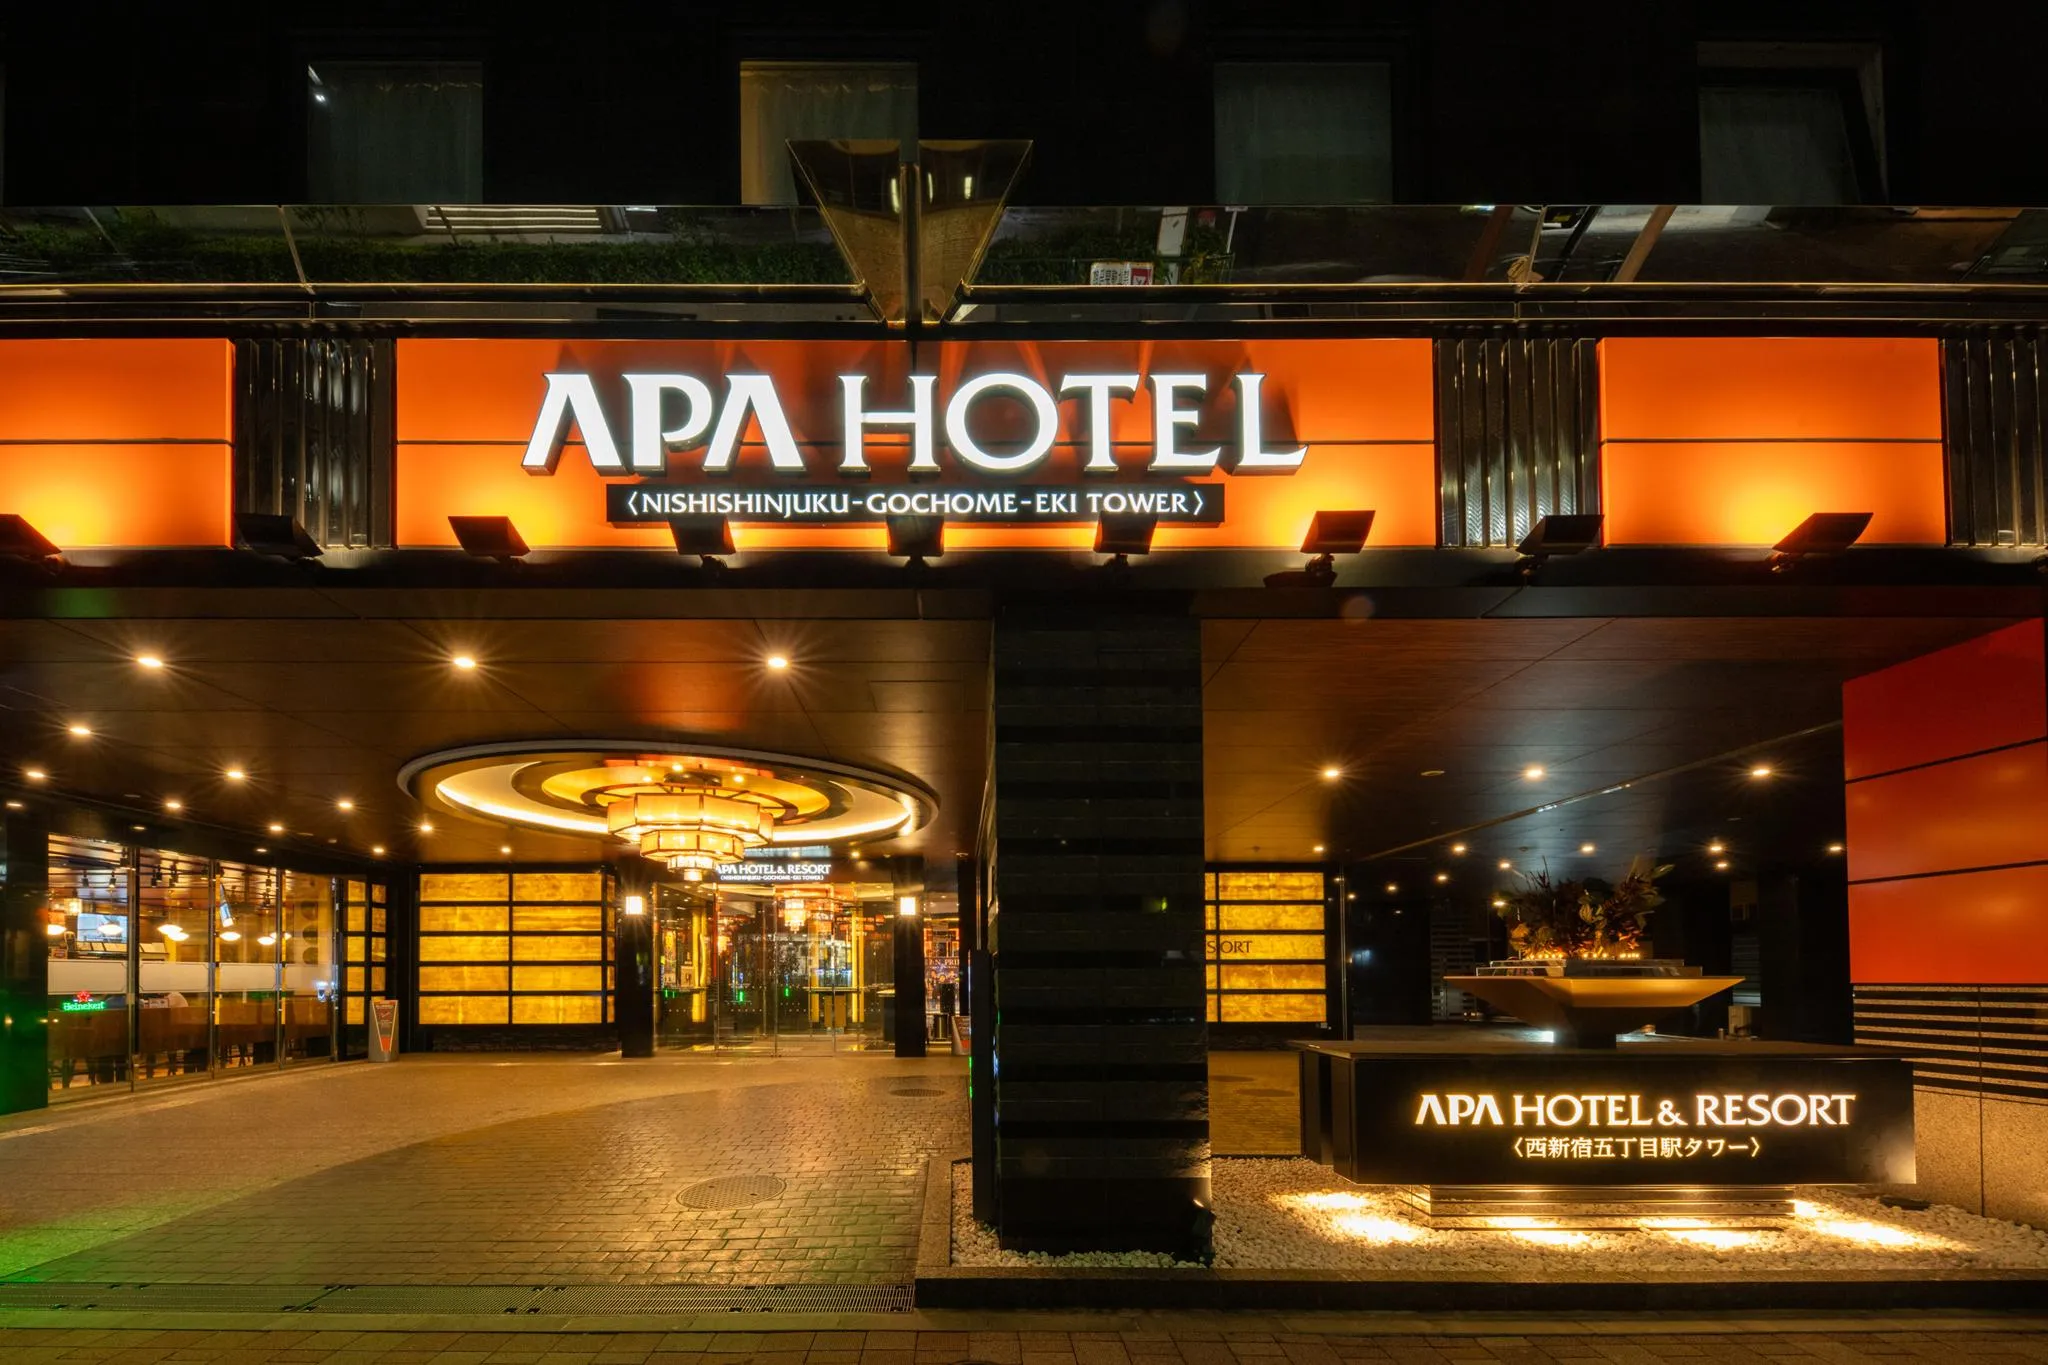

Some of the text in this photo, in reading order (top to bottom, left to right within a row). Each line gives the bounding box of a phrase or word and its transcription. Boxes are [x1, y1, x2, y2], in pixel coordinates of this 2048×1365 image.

[521, 372, 1308, 470] APA HOTEL
[715, 864, 831, 874] APA HOTEL & RESORT
[1418, 1094, 1856, 1126] APA HOTEL & RESORT
